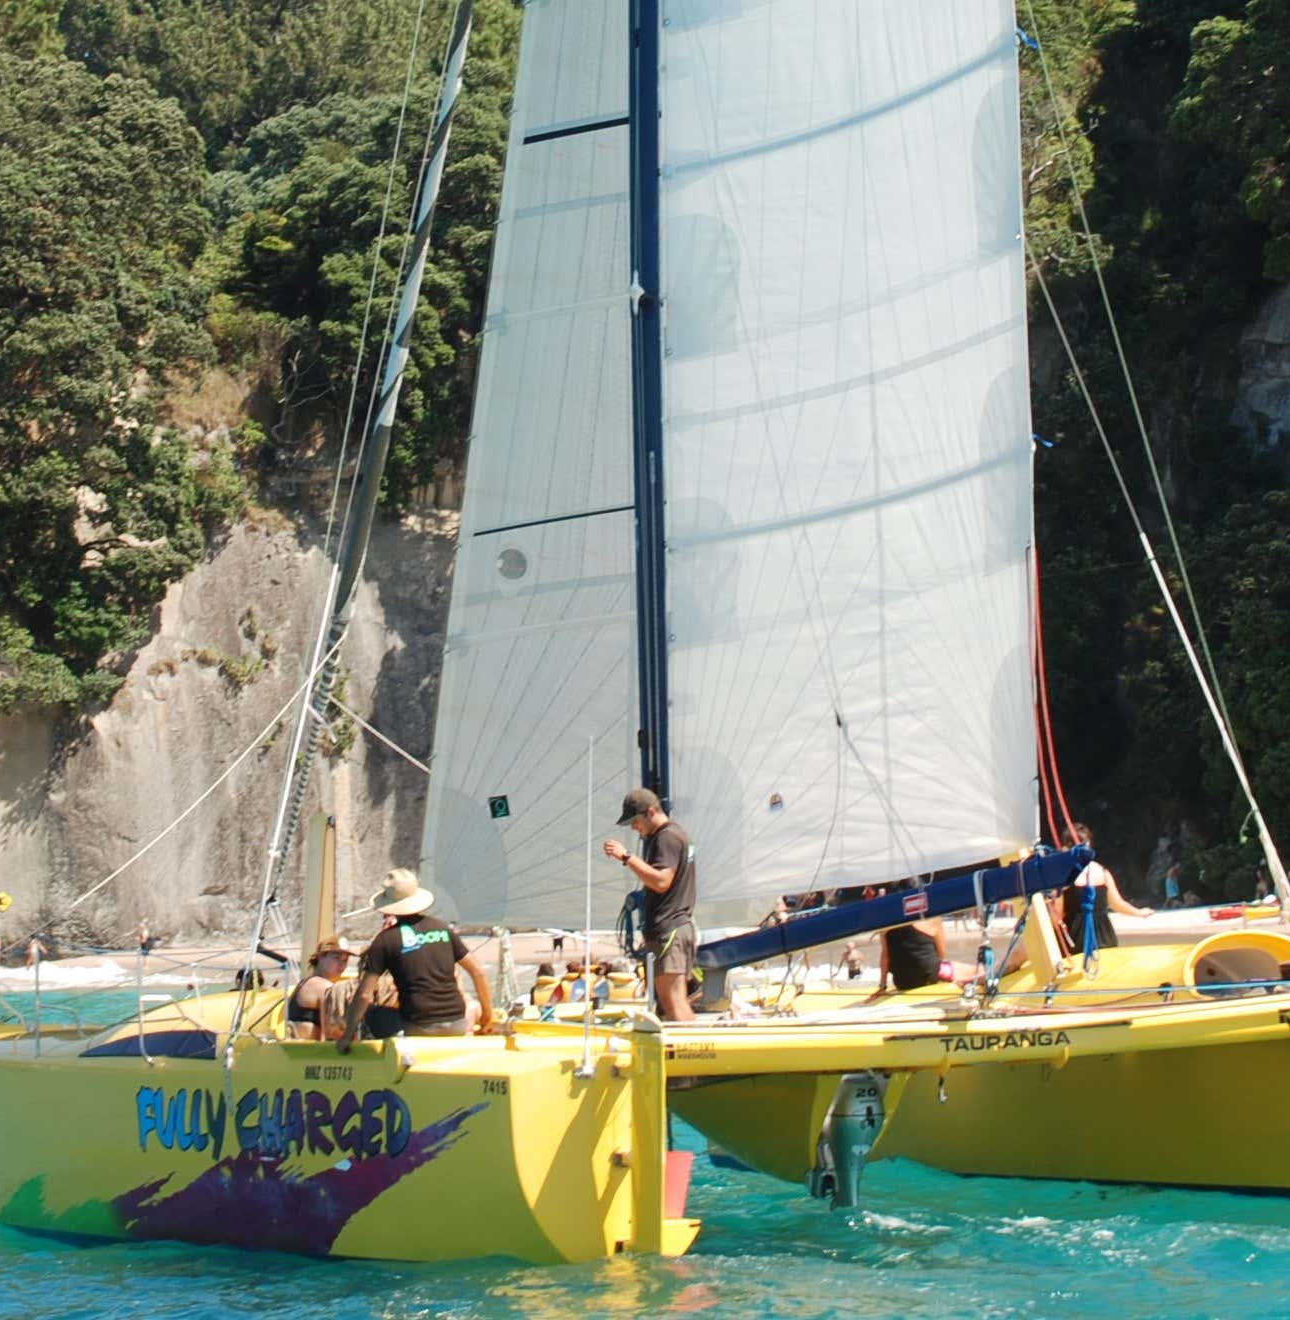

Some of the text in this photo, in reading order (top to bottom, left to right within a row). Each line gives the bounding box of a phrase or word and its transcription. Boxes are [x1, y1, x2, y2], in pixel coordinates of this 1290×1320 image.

[940, 1031, 1071, 1053] TAURANGA
[483, 1080, 508, 1095] 7415
[856, 1088, 877, 1098] 20
[136, 1086, 412, 1160] FULLY CHARGED
